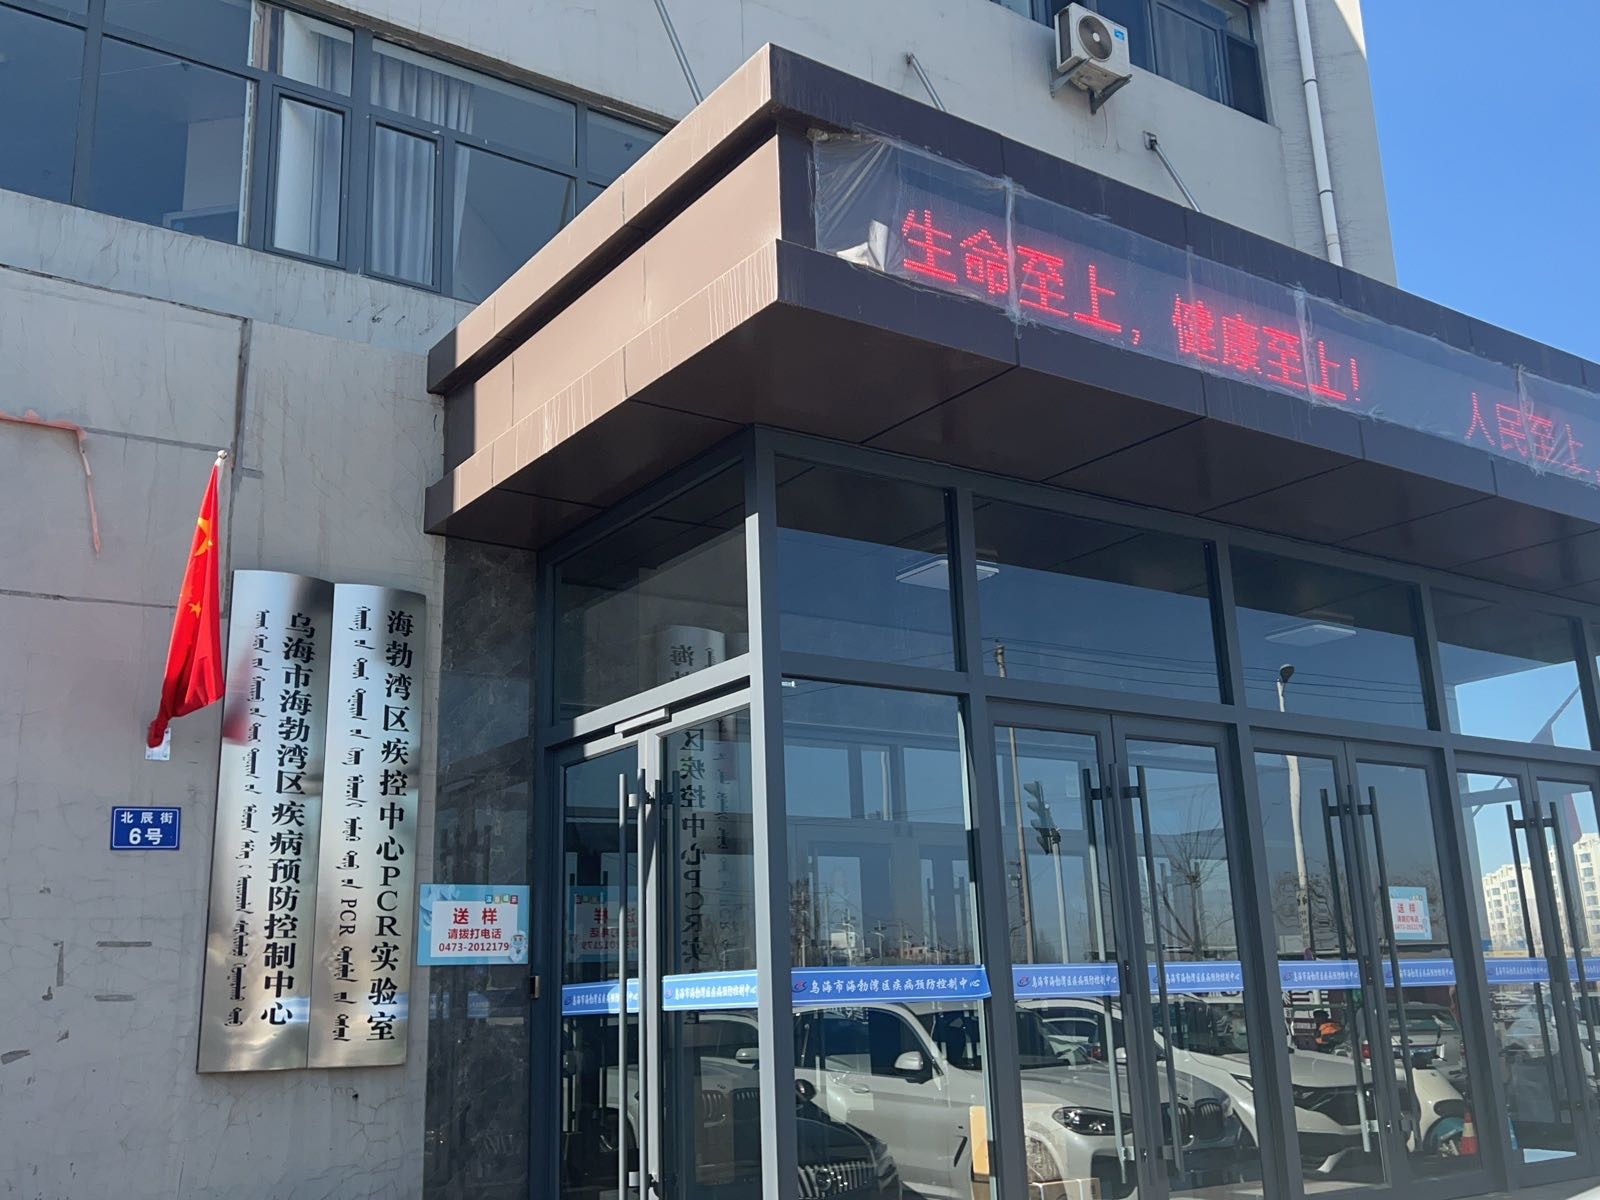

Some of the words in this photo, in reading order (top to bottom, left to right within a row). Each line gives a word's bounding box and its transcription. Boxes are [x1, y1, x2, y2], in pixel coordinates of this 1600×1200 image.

[120, 811, 173, 824] 北辰街
[260, 611, 316, 1025] 乌海市海勃湾区疾病预防控制中心
[366, 609, 415, 1041] 海勃湾区疾控中心PCR实验室
[129, 827, 163, 845] 6号
[339, 898, 357, 936] PCR
[448, 928, 501, 940] 请拨打电话
[438, 942, 509, 951] 0473-2012179
[809, 976, 981, 994] 乌海市海勃湾区疾病预防控制中心
